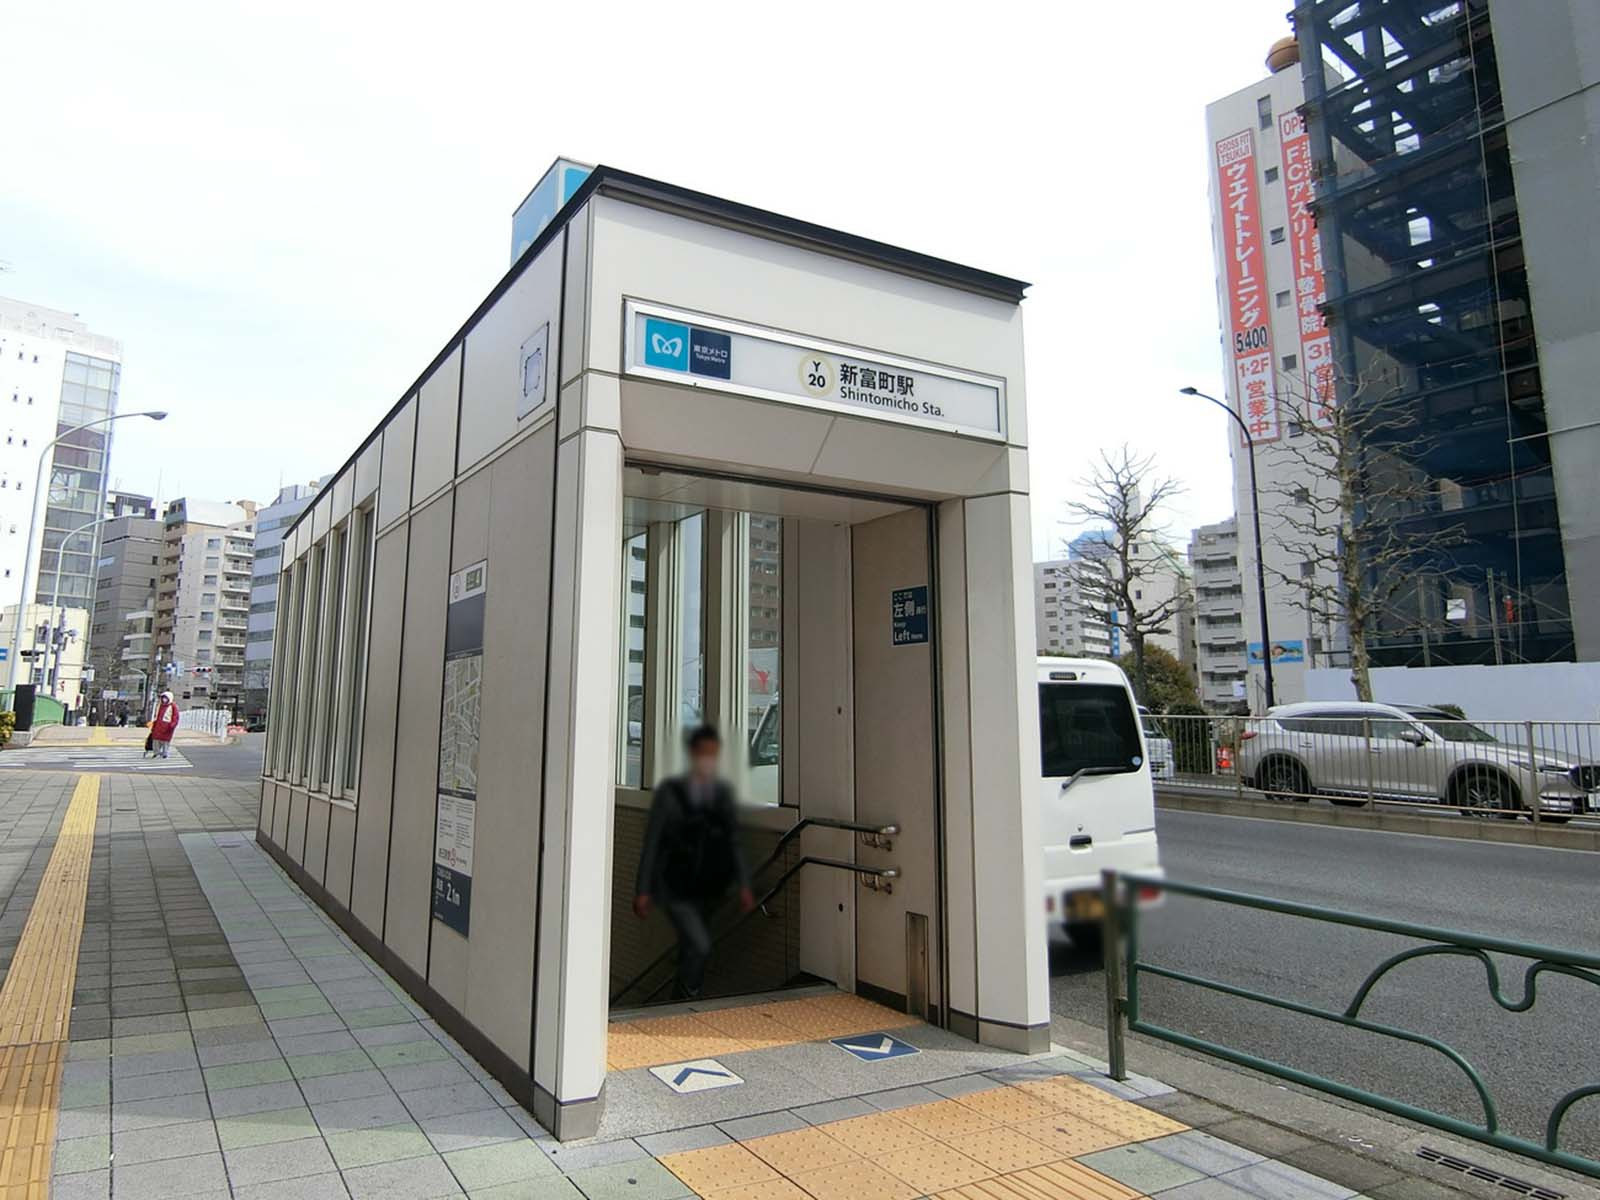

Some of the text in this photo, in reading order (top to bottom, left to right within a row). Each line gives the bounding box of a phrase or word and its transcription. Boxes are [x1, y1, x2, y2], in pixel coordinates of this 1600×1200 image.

[693, 344, 729, 359] 東京メトロ
[813, 361, 821, 372] Y
[808, 373, 826, 388] 20
[840, 363, 914, 397] 新富町駅
[840, 385, 945, 417] Shintomicho Sta.
[1246, 380, 1270, 437] 営業中
